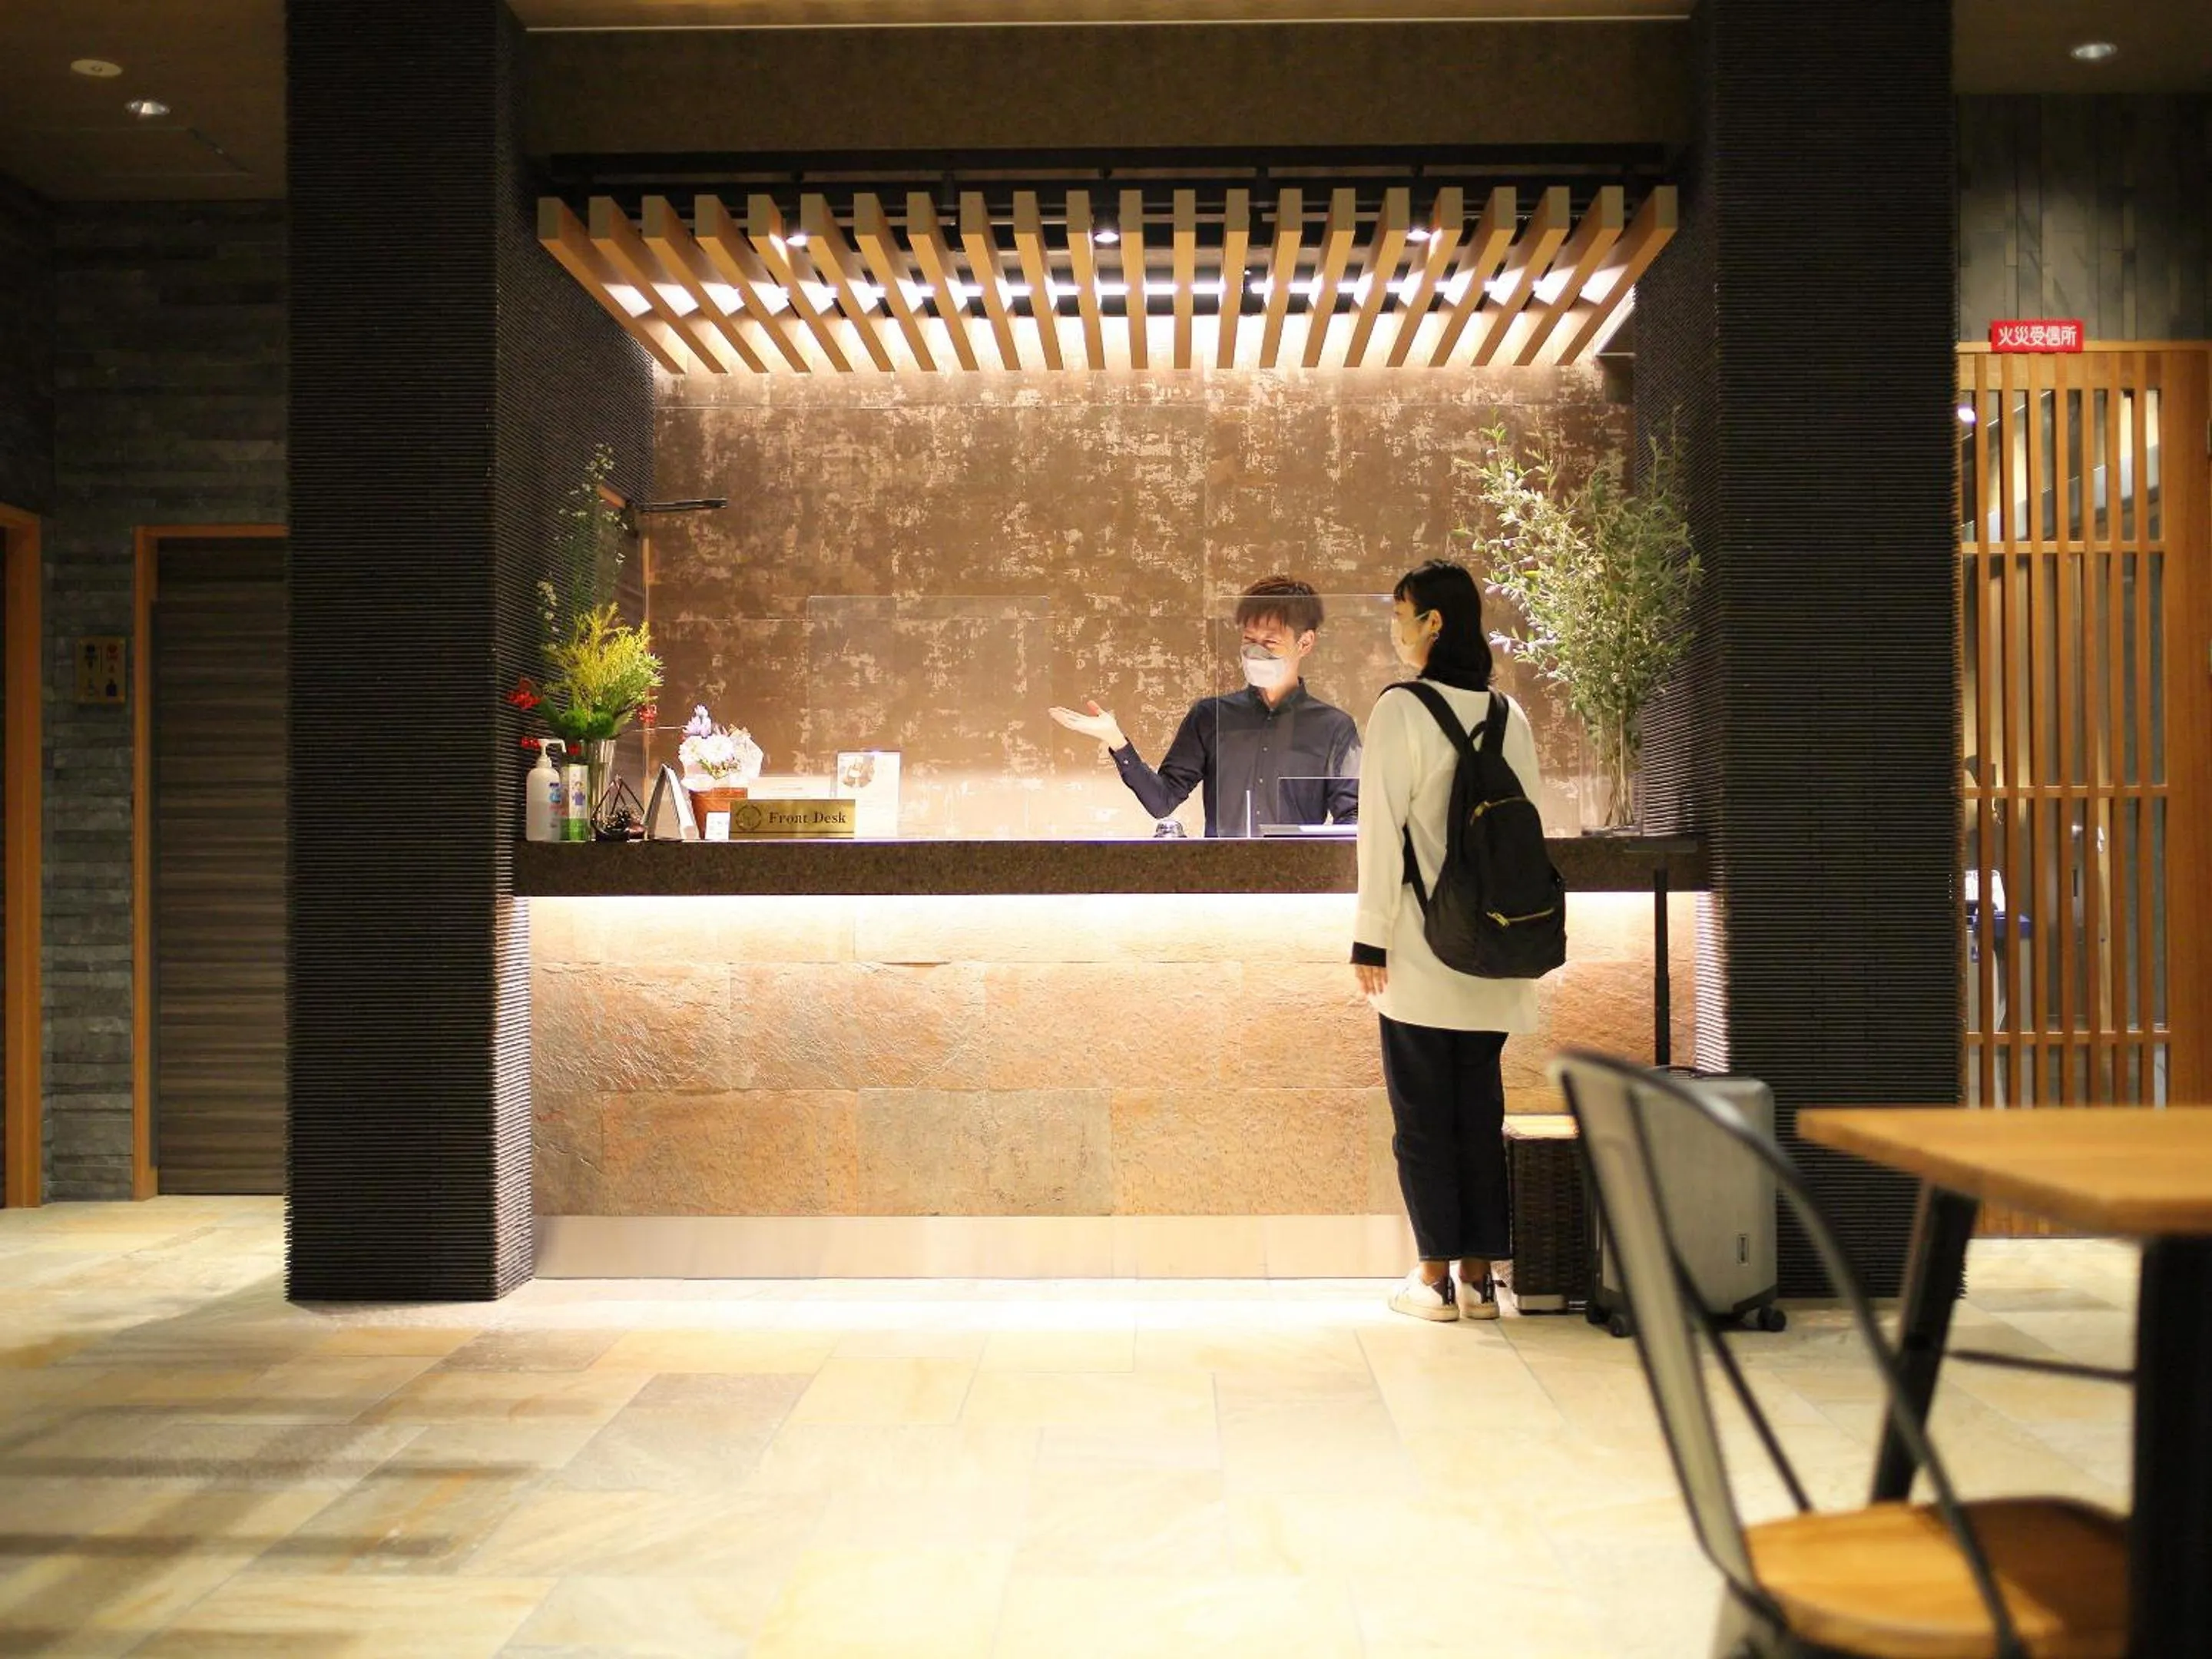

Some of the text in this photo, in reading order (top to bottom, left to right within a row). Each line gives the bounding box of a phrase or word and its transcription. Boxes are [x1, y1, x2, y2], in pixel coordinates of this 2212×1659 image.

[1998, 325, 2077, 347] 火災受信所
[769, 811, 846, 824] Front Desk
